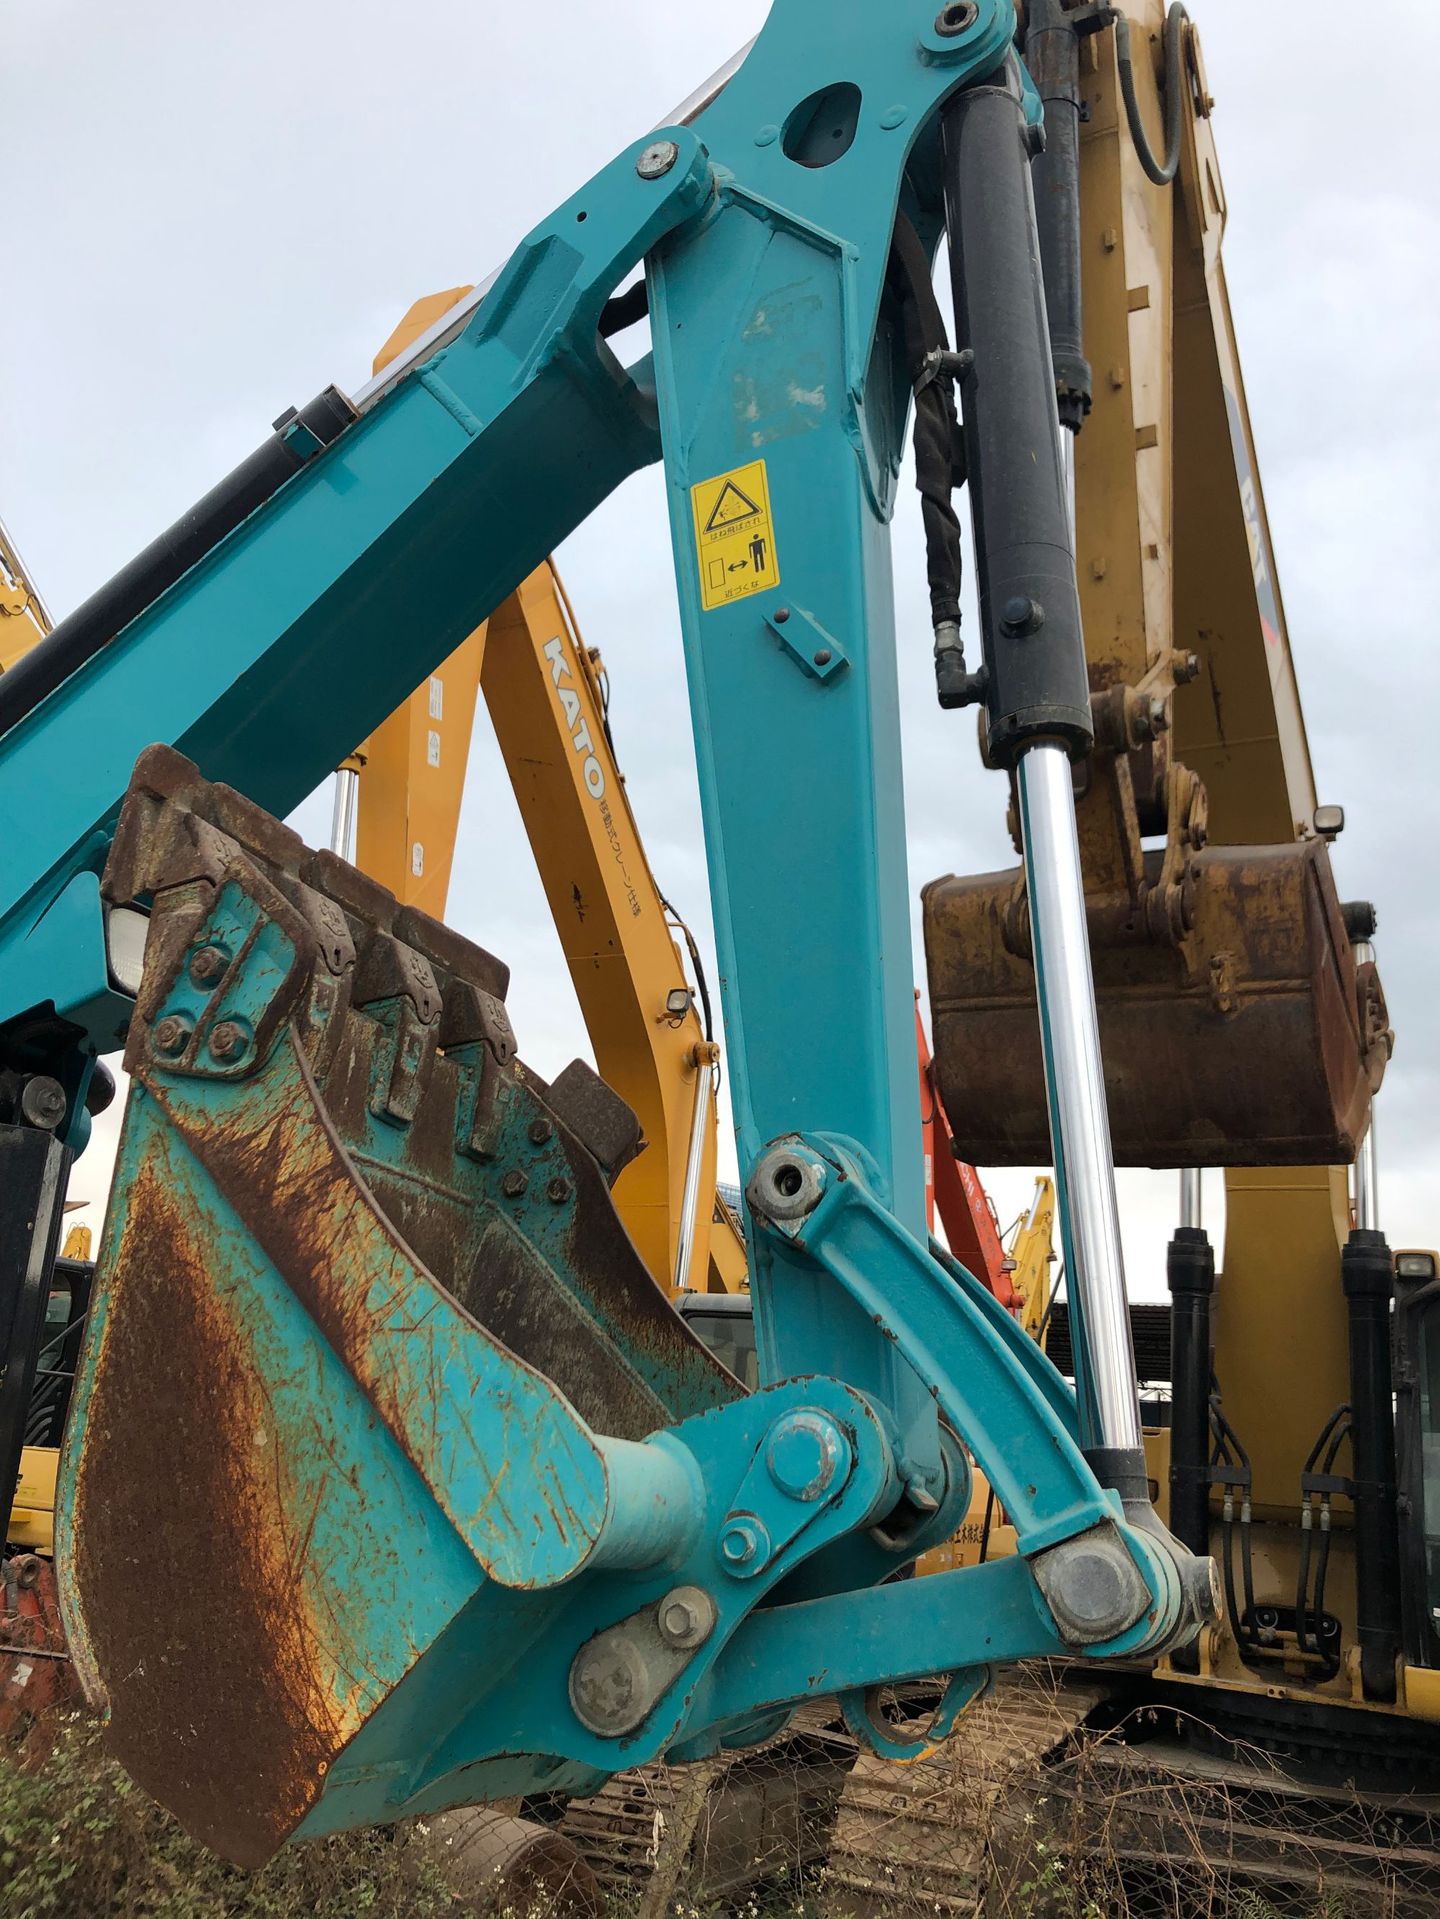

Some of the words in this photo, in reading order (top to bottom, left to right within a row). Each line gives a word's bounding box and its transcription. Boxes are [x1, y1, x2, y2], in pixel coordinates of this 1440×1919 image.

[710, 516, 761, 541] はね飛ばされ
[724, 580, 760, 598] 近づくな
[542, 635, 606, 801] KATO
[598, 799, 641, 918] 移動式クレーン仕様
